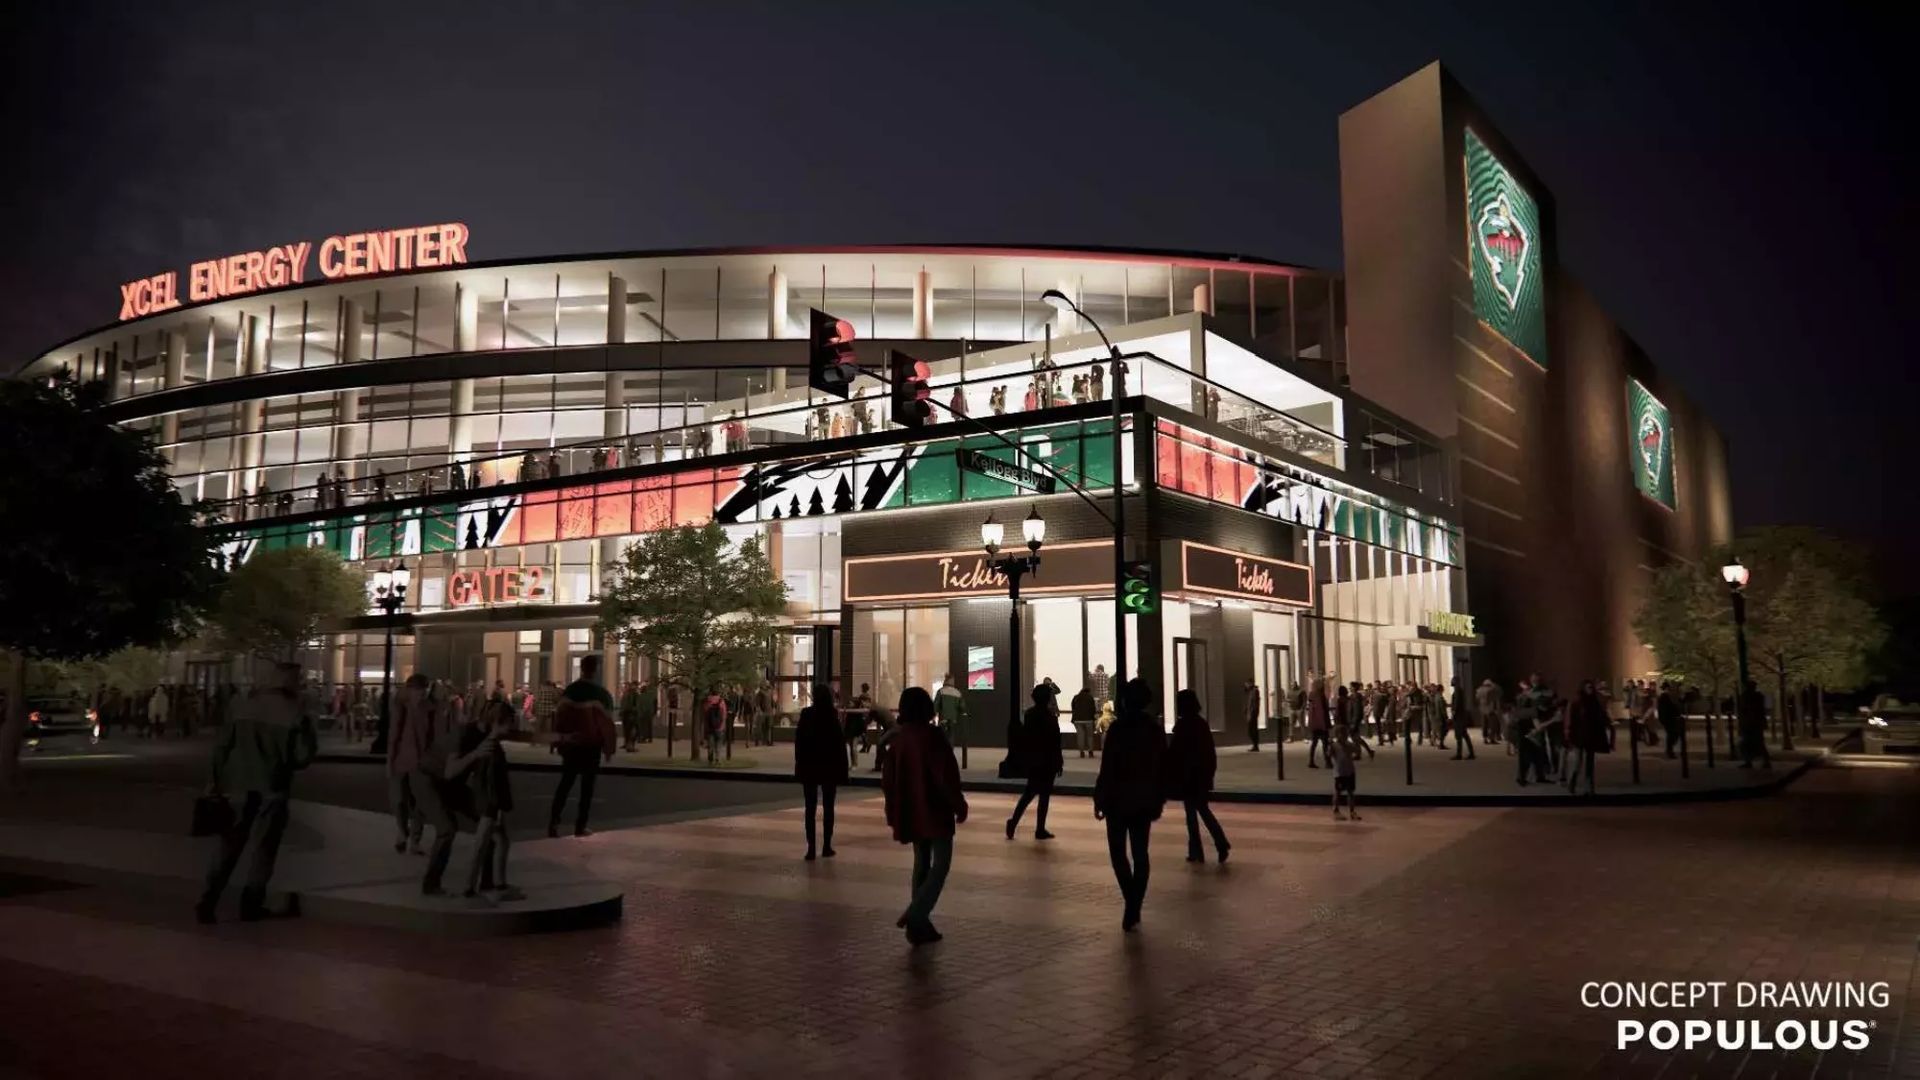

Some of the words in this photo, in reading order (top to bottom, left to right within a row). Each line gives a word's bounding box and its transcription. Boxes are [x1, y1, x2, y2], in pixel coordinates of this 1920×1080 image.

[119, 271, 181, 320] XCEL
[189, 241, 312, 302] ENERGY
[319, 222, 470, 279] CENTER
[970, 451, 1019, 482] Kellogg
[1020, 470, 1048, 489] Blvd
[448, 566, 524, 607] GATE
[527, 565, 546, 601] 2
[1235, 558, 1274, 594] Tickets
